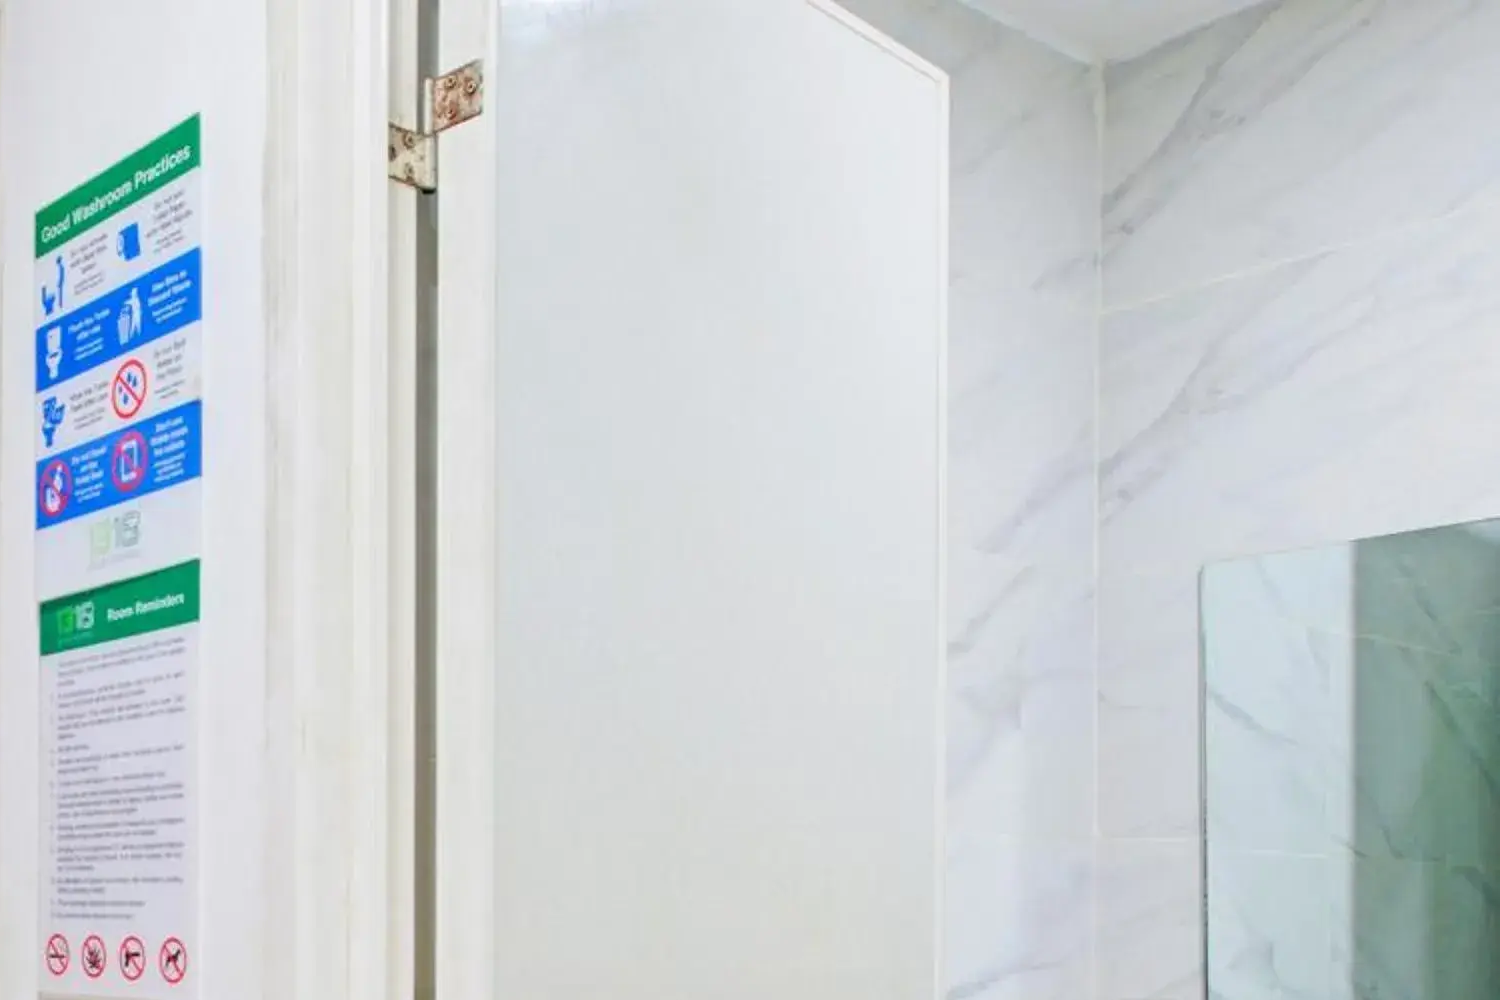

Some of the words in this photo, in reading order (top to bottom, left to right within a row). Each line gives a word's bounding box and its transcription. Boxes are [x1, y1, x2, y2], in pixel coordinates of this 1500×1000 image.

[41, 213, 70, 243] Good
[71, 180, 132, 225] Washroom
[134, 145, 191, 189] Practices
[107, 606, 134, 622] Room
[135, 593, 184, 616] Reminders
